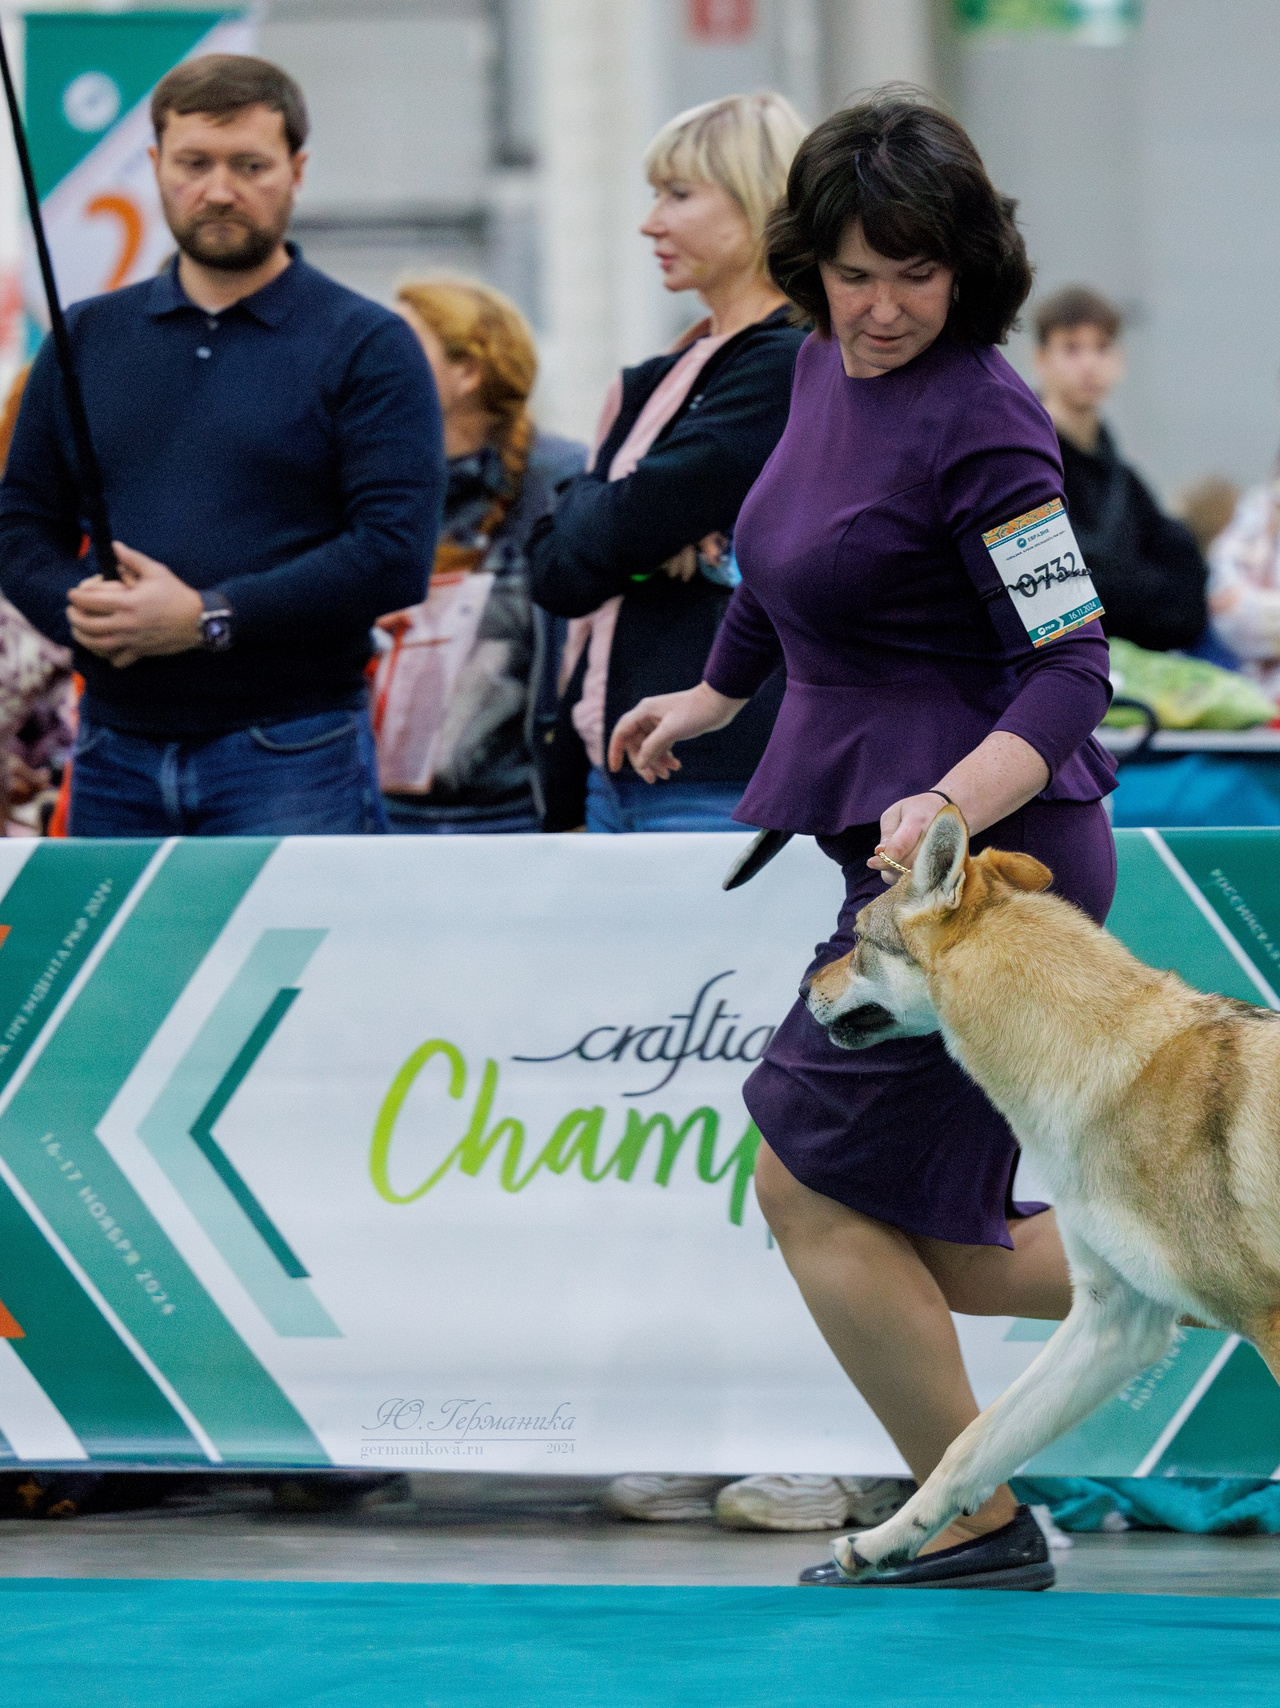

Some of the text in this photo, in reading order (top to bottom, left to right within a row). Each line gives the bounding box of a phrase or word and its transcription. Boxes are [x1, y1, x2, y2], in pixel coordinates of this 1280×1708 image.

[1018, 551, 1079, 598] 0732
[1068, 600, 1097, 621] 16.11.2024
[40, 1132, 177, 1316] 16-17 НОЯБРЯ 2024
